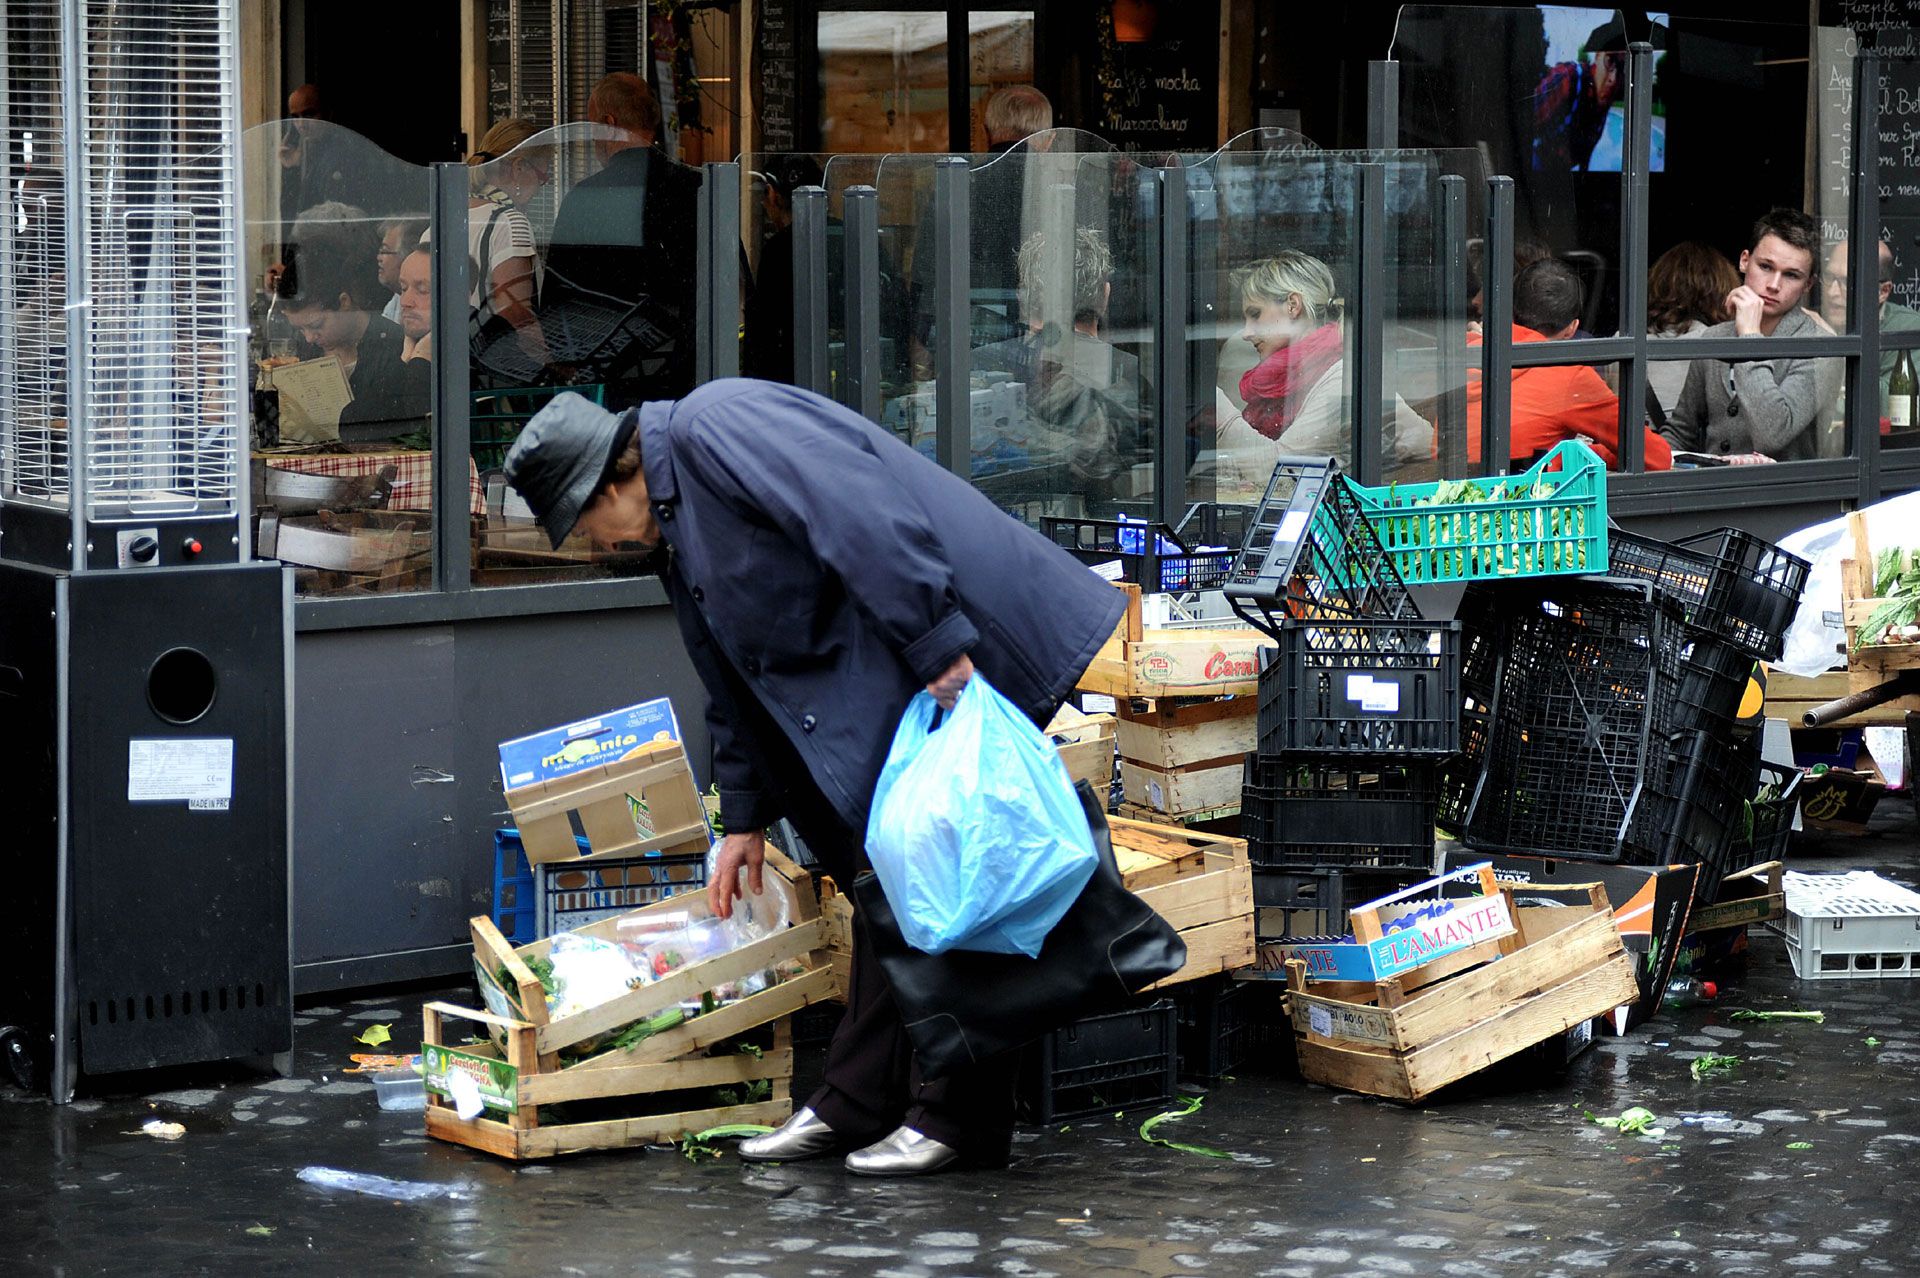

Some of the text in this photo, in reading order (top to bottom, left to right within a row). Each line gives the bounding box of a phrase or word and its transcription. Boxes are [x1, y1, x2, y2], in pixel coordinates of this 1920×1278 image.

[1154, 67, 1201, 92] mocha
[190, 798, 228, 808] MADE IN PRC
[1390, 904, 1502, 966] L'AMANTE
